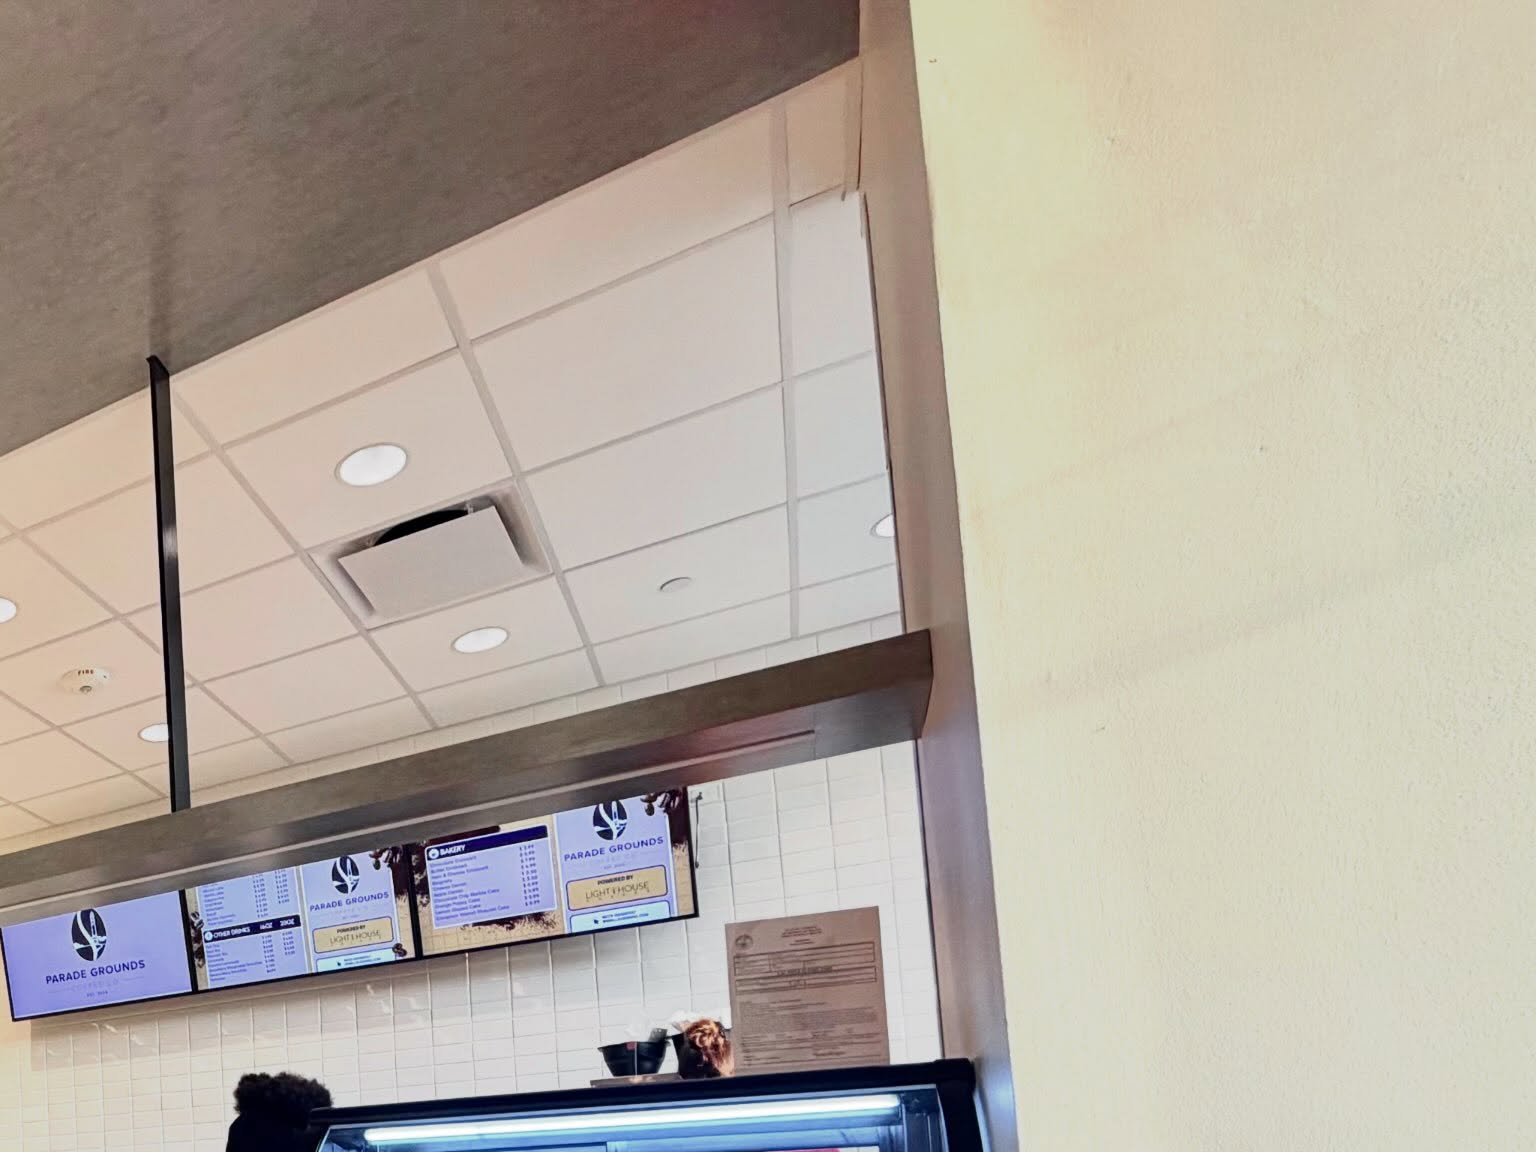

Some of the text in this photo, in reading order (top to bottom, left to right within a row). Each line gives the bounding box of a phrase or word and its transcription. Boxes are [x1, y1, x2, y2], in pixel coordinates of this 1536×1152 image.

[440, 844, 466, 856] BAKERY
[564, 836, 664, 861] PARADE GROUNDS
[310, 891, 389, 912] PARADE GROUNDS
[46, 960, 146, 984] PARADE GROUNDS
